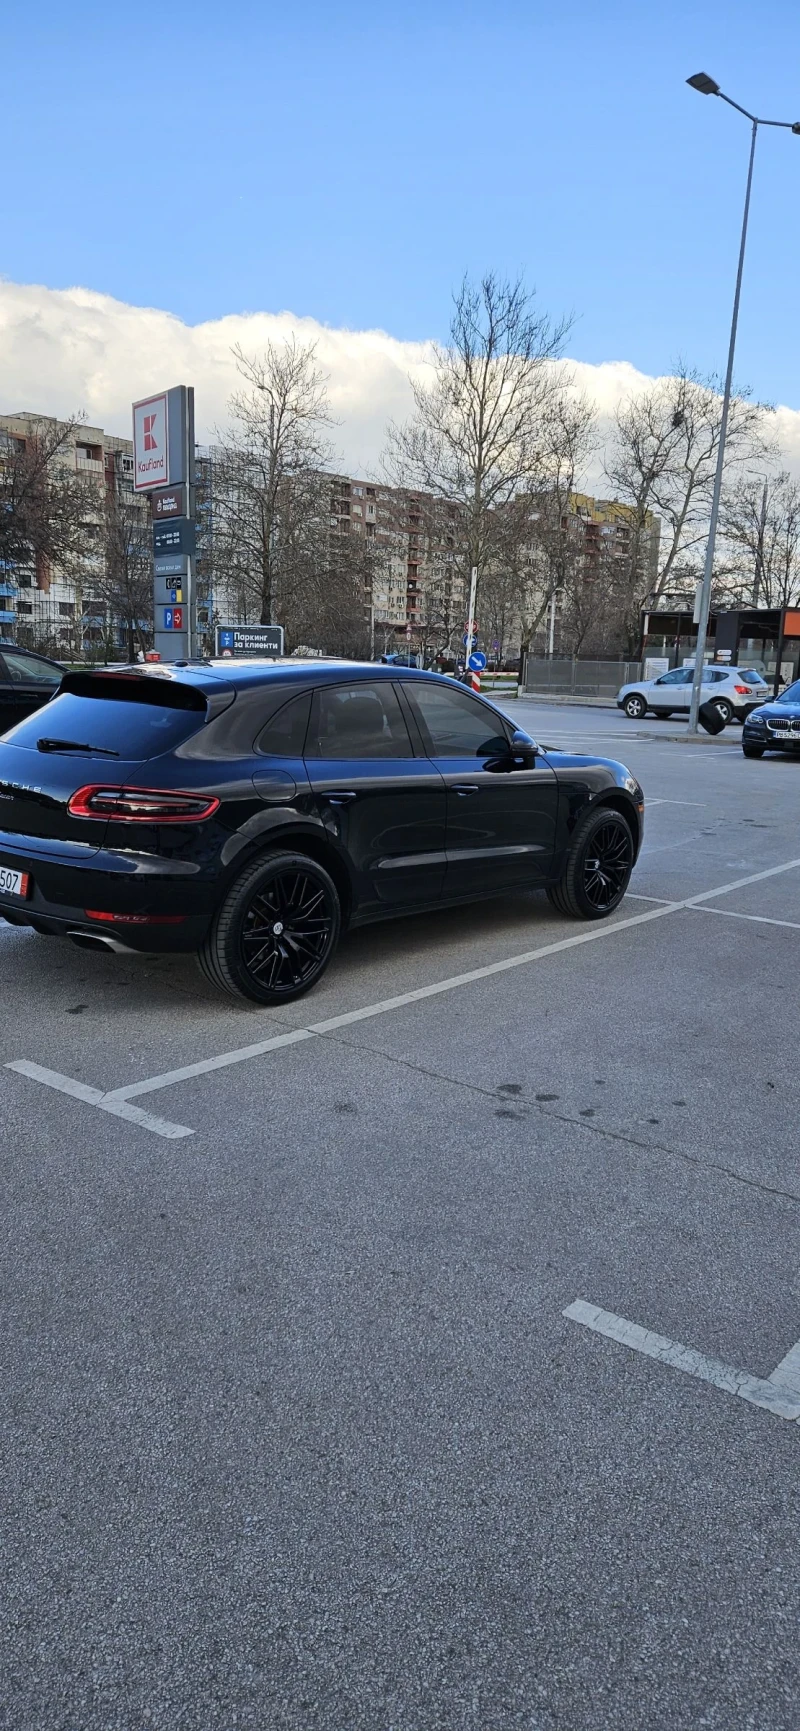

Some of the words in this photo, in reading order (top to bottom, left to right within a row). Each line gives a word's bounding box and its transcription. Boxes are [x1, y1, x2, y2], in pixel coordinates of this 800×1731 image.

[143, 413, 158, 451] K
[138, 455, 164, 473] Kaufland
[166, 612, 172, 625] P
[234, 632, 268, 643] Паркинг
[0, 779, 42, 792] SCHE
